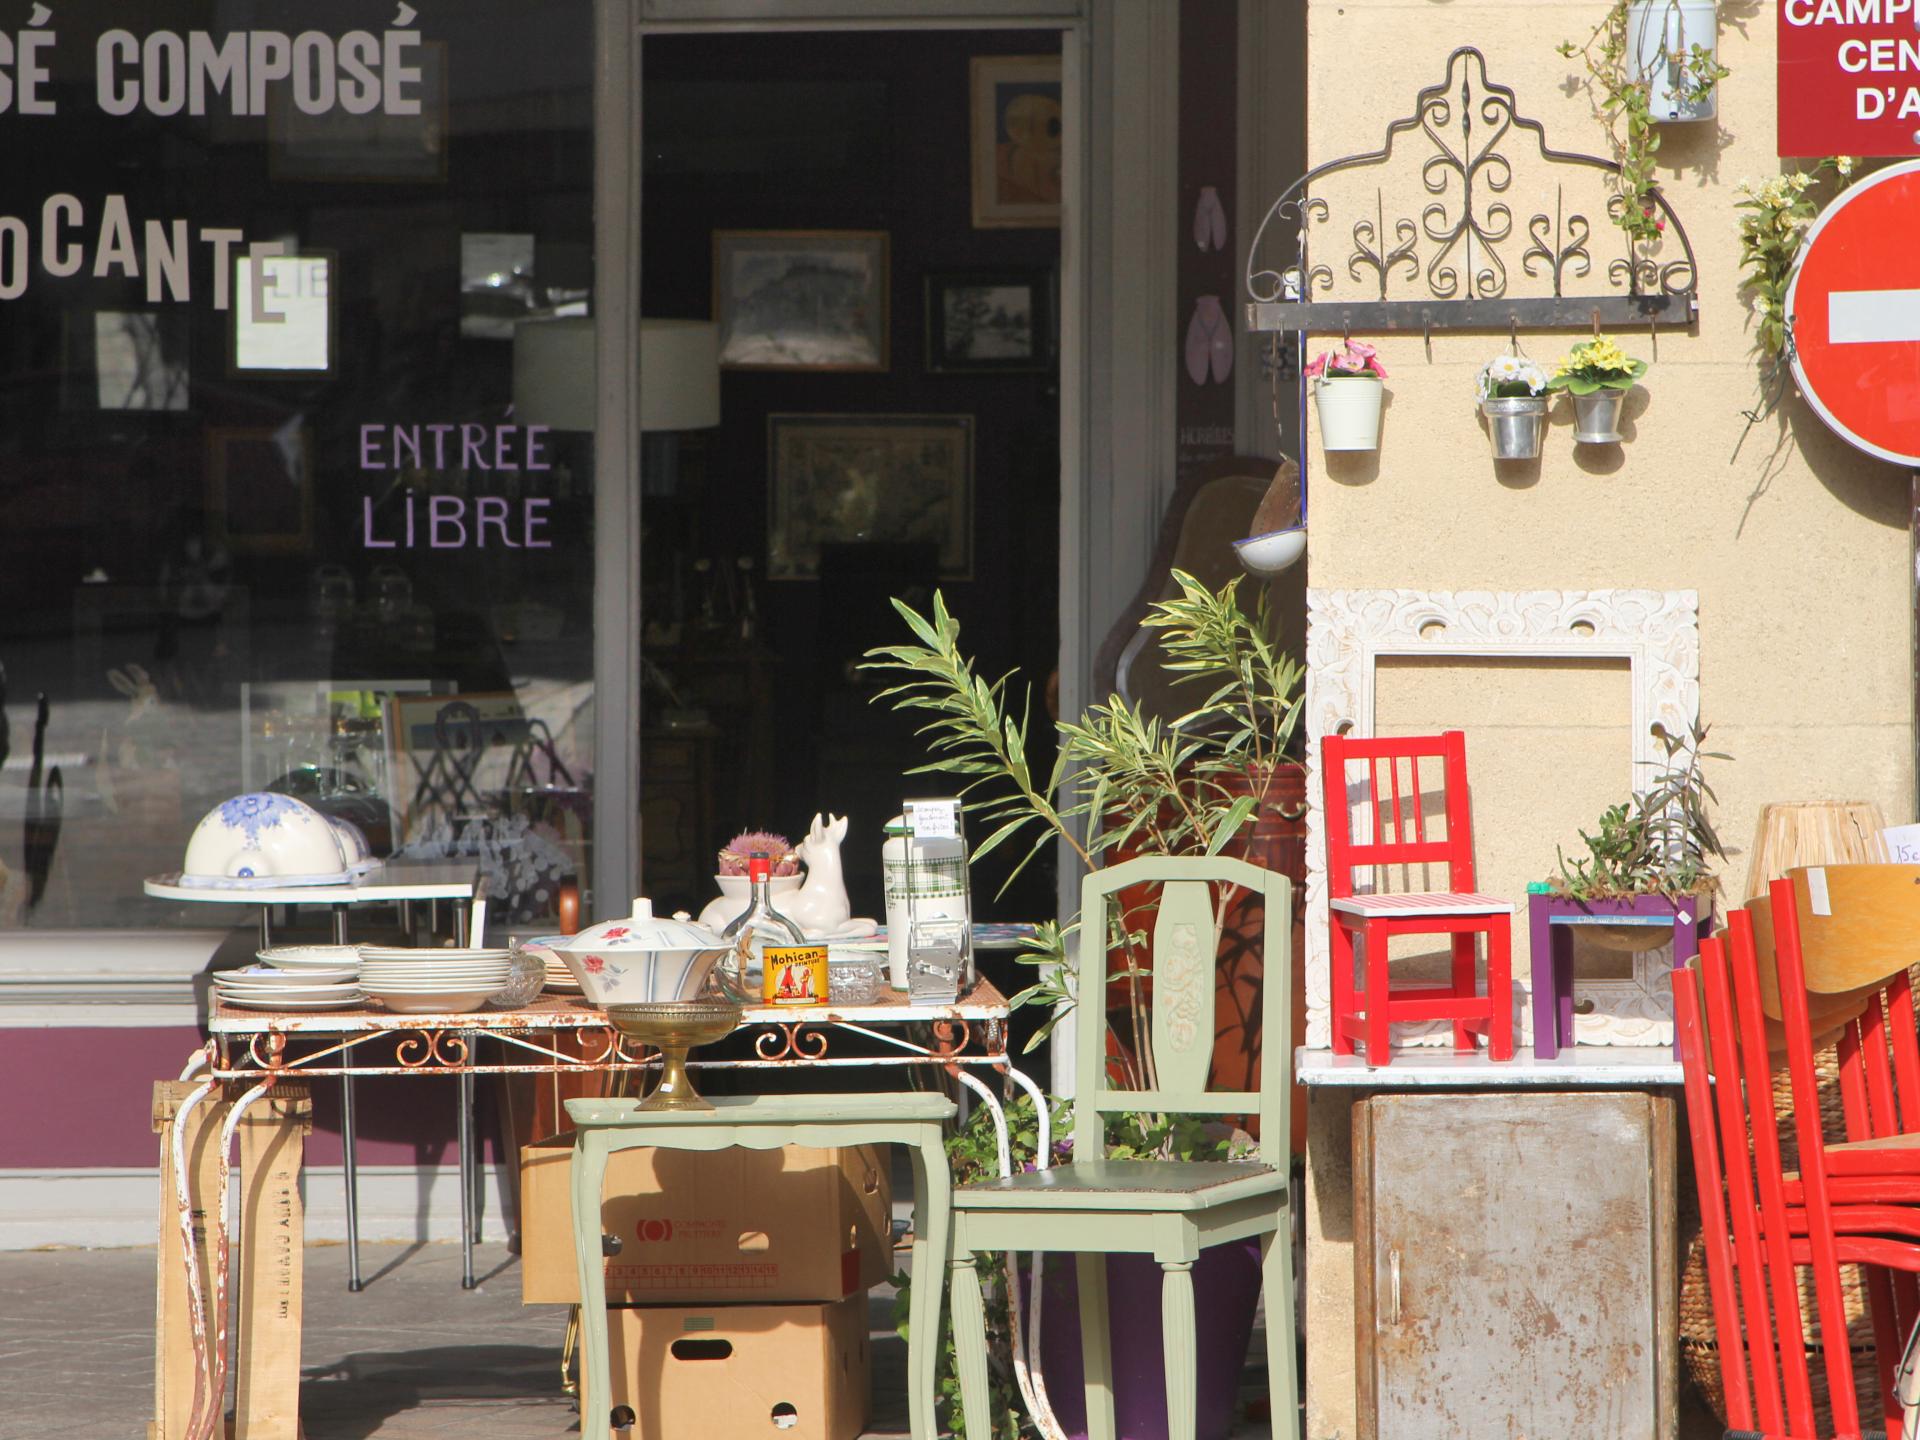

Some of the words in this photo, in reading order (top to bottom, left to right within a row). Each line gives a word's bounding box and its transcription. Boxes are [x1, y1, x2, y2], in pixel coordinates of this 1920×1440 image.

[97, 2, 421, 116] COMPOSÉ
[1838, 39, 1920, 72] CEN
[361, 403, 551, 470] ENTRÉE
[771, 951, 818, 970] Mohican
